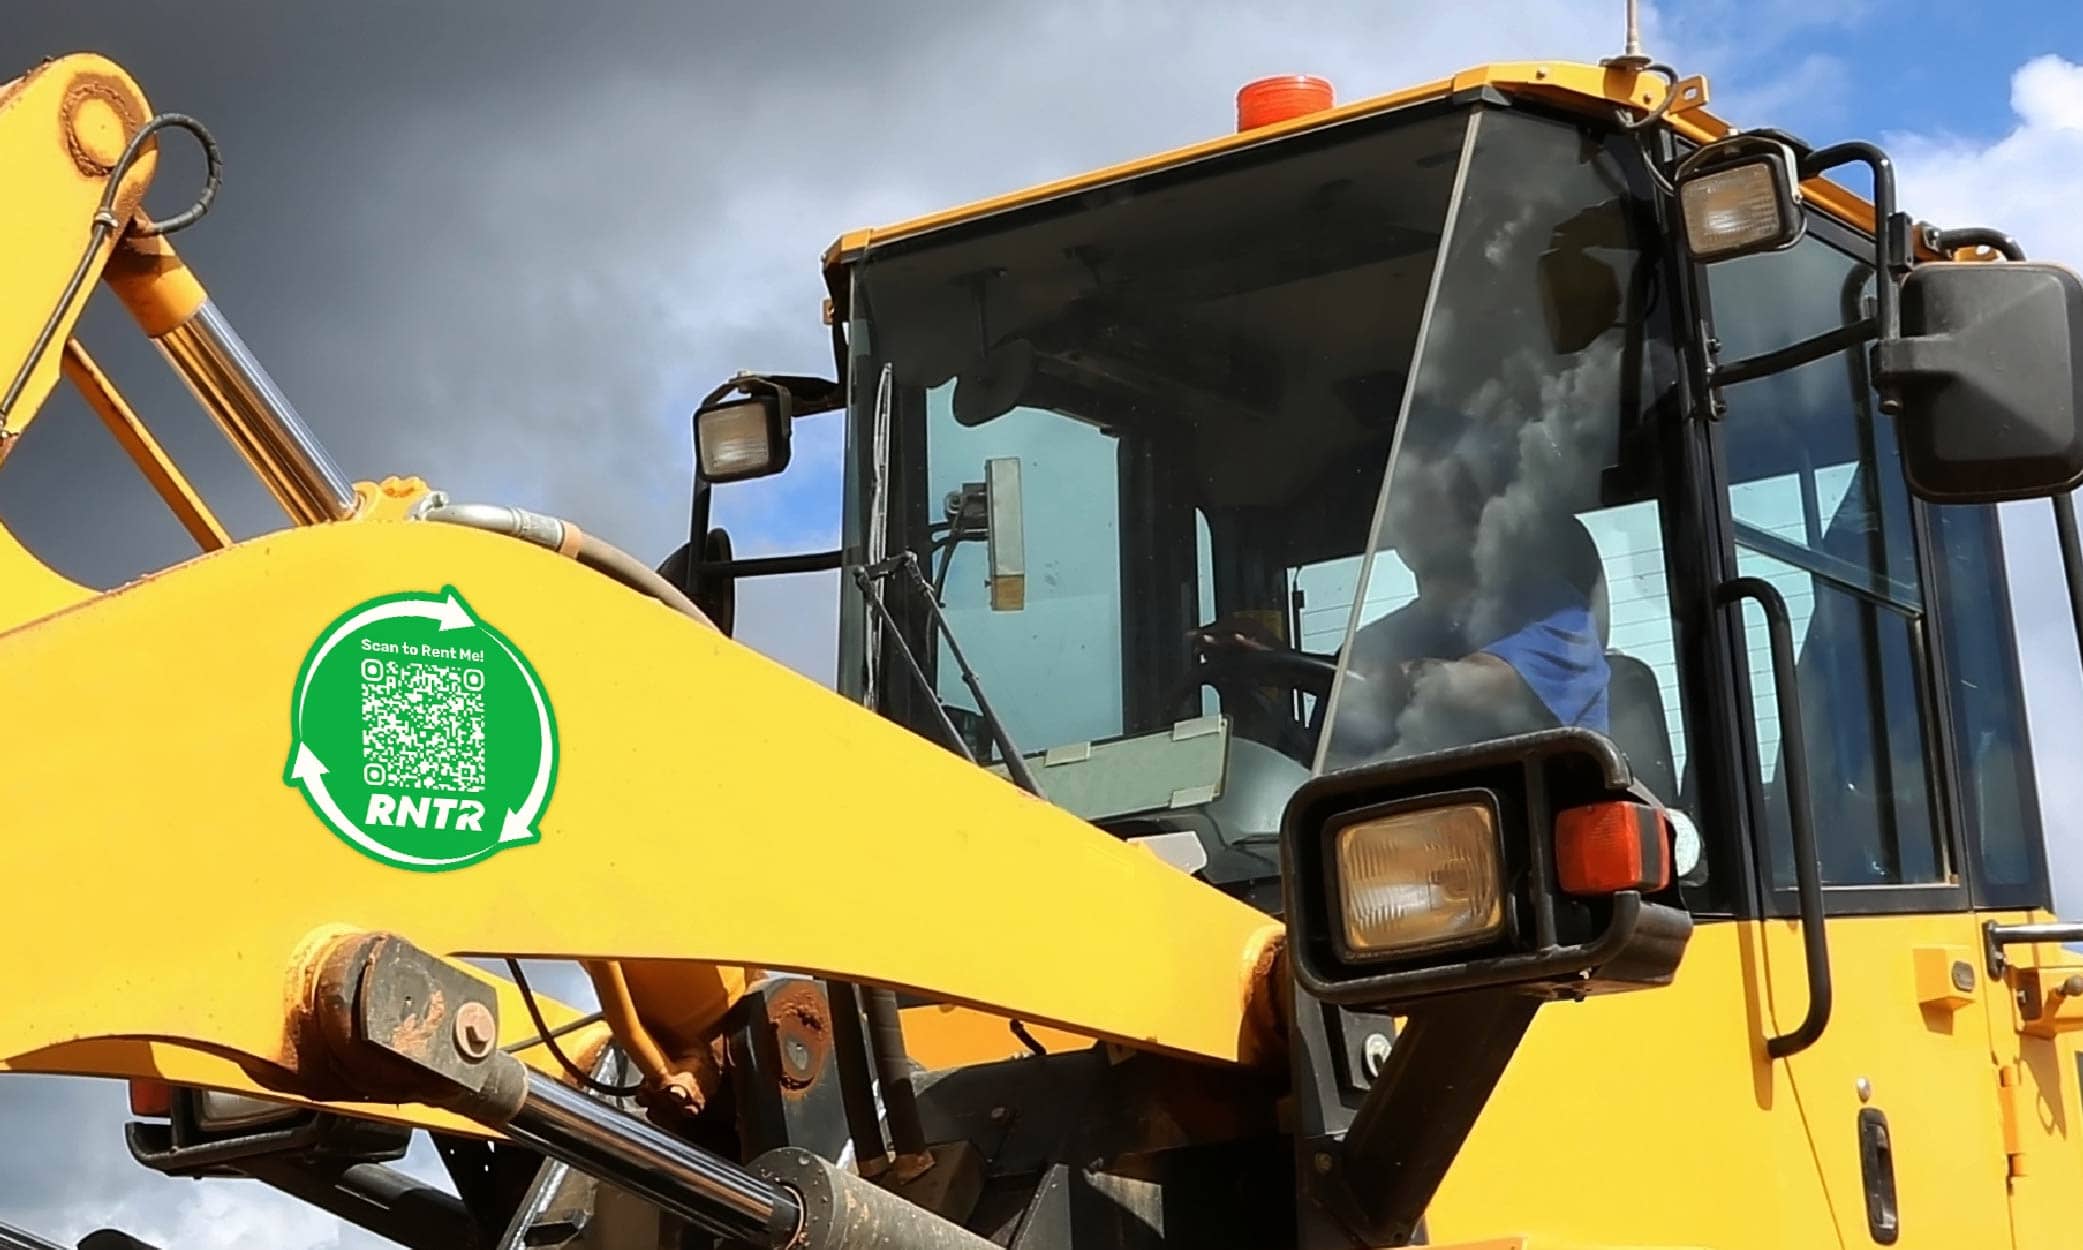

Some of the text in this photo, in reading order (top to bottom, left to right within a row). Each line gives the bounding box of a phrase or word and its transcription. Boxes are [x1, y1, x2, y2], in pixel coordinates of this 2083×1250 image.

[361, 639, 485, 662] Scan to Rent Me!
[365, 793, 486, 831] RNTR
